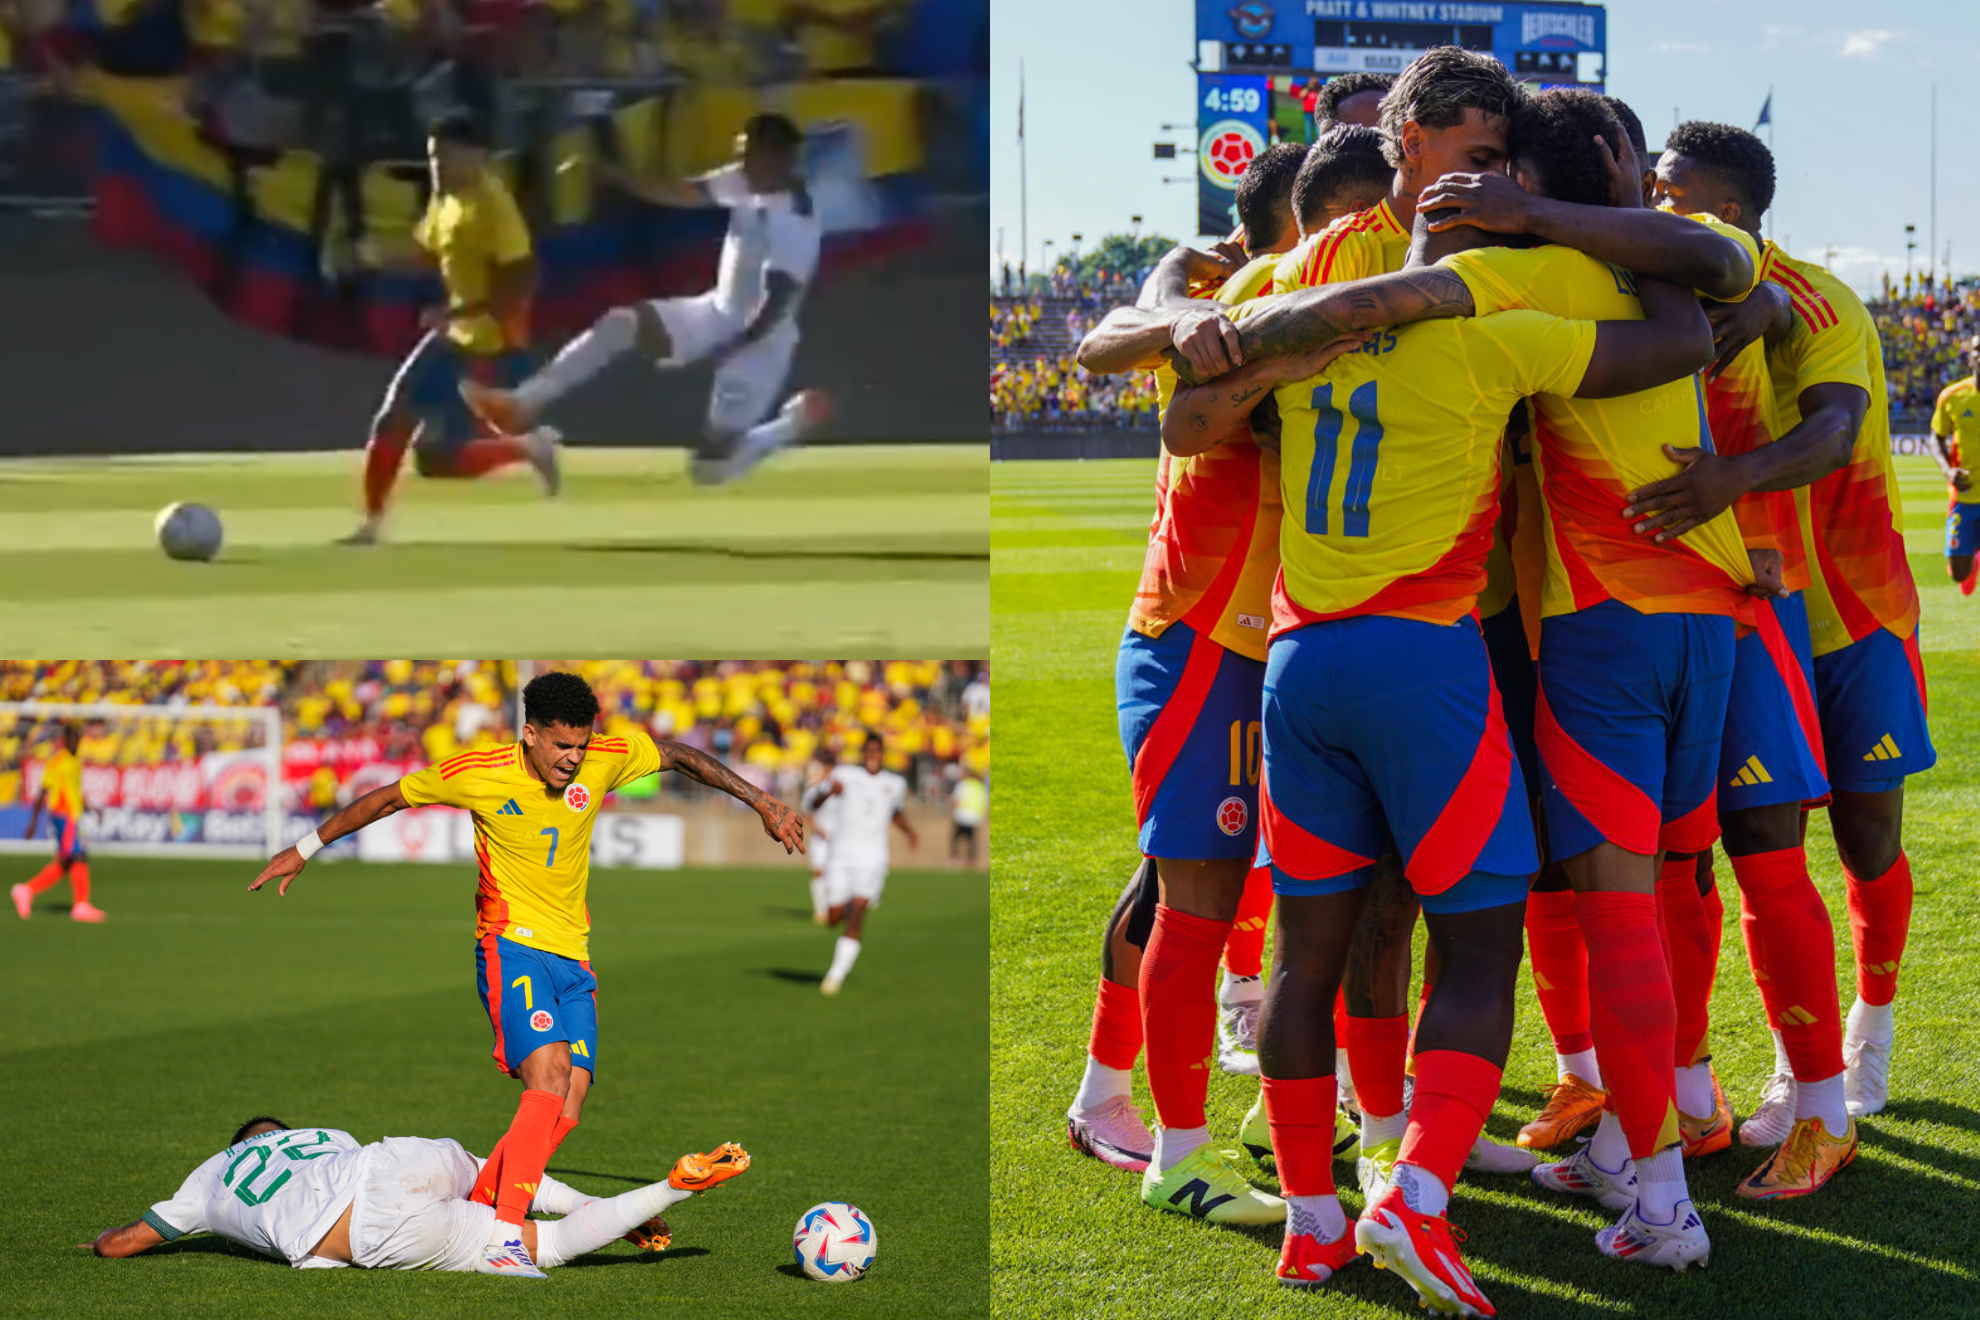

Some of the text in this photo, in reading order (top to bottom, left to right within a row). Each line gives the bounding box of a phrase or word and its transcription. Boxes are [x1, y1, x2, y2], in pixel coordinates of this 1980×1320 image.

[1305, 1, 1504, 22] PRATT & WHITNEY STADIUM
[1204, 86, 1261, 113] 4:59
[1305, 380, 1384, 538] 11
[1949, 513, 1962, 535] 2
[1229, 719, 1262, 786] 10
[540, 827, 560, 867] 7
[512, 975, 533, 1010] 7
[224, 1131, 339, 1207] 22
